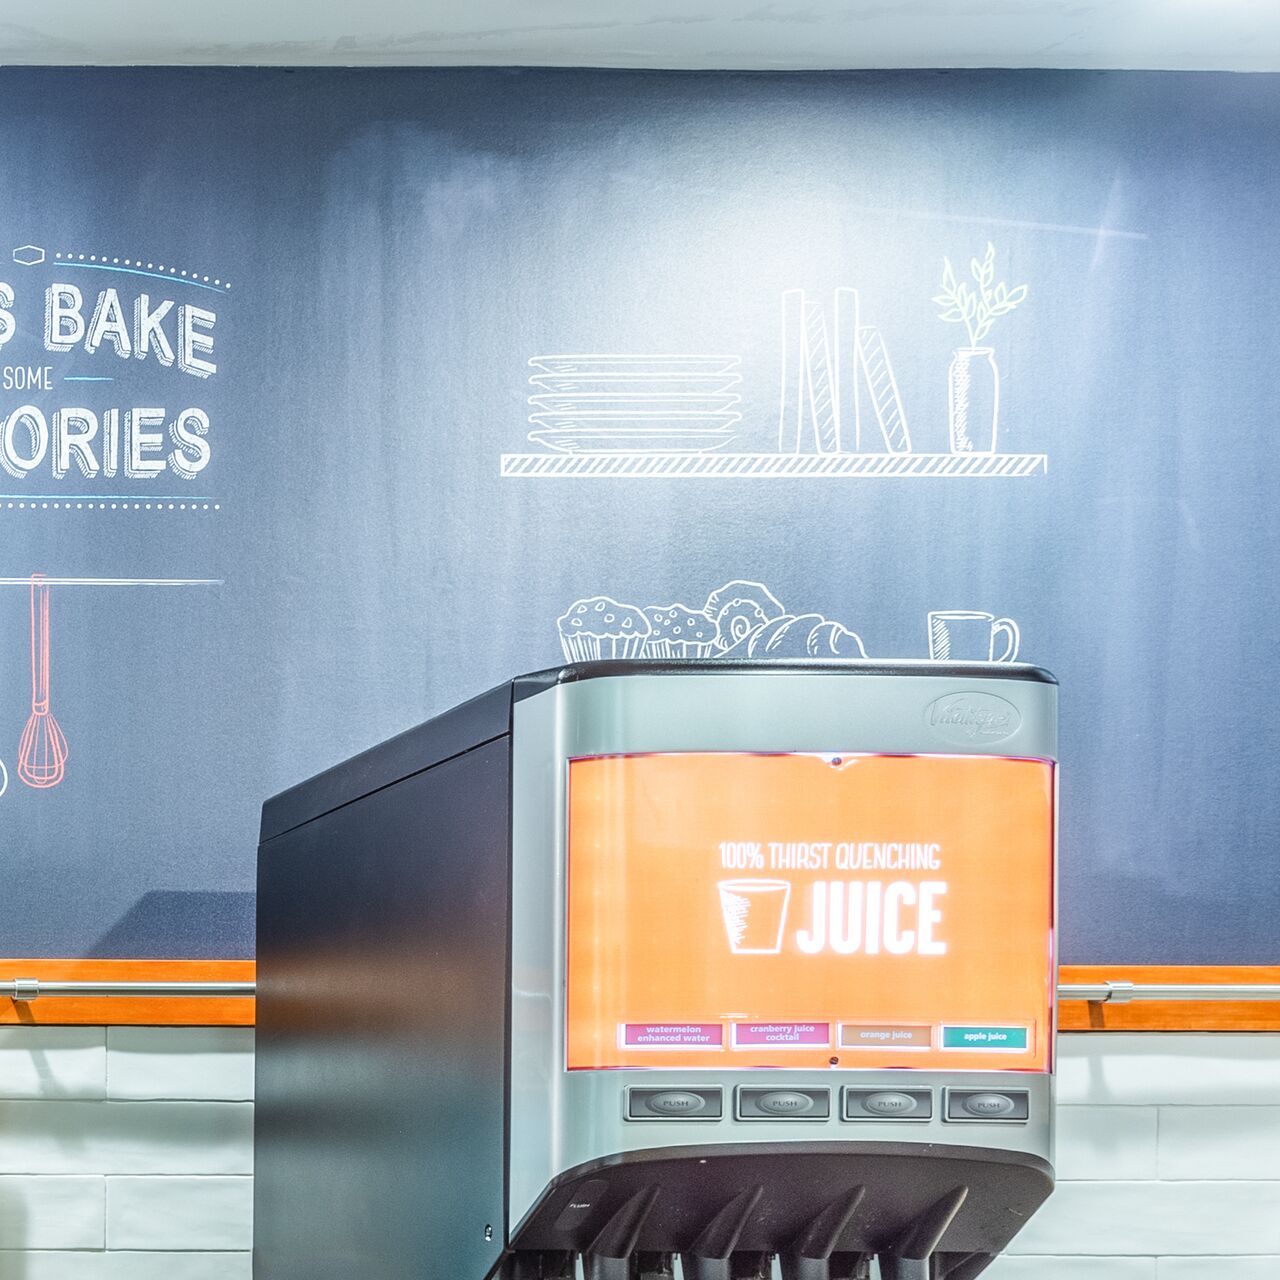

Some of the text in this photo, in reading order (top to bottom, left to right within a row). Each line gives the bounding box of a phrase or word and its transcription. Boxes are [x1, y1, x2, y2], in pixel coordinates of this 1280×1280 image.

[44, 283, 218, 379] BAKE
[2, 366, 53, 391] SOME
[718, 842, 941, 870] 100% THIRST QUENCHING
[796, 880, 948, 955] JUICE
[750, 1025, 816, 1035] cranberry juice
[860, 1030, 913, 1040] orange juice
[637, 1034, 681, 1042] enhanced
[766, 1033, 800, 1041] cocktail
[964, 1031, 1008, 1042] apple juice
